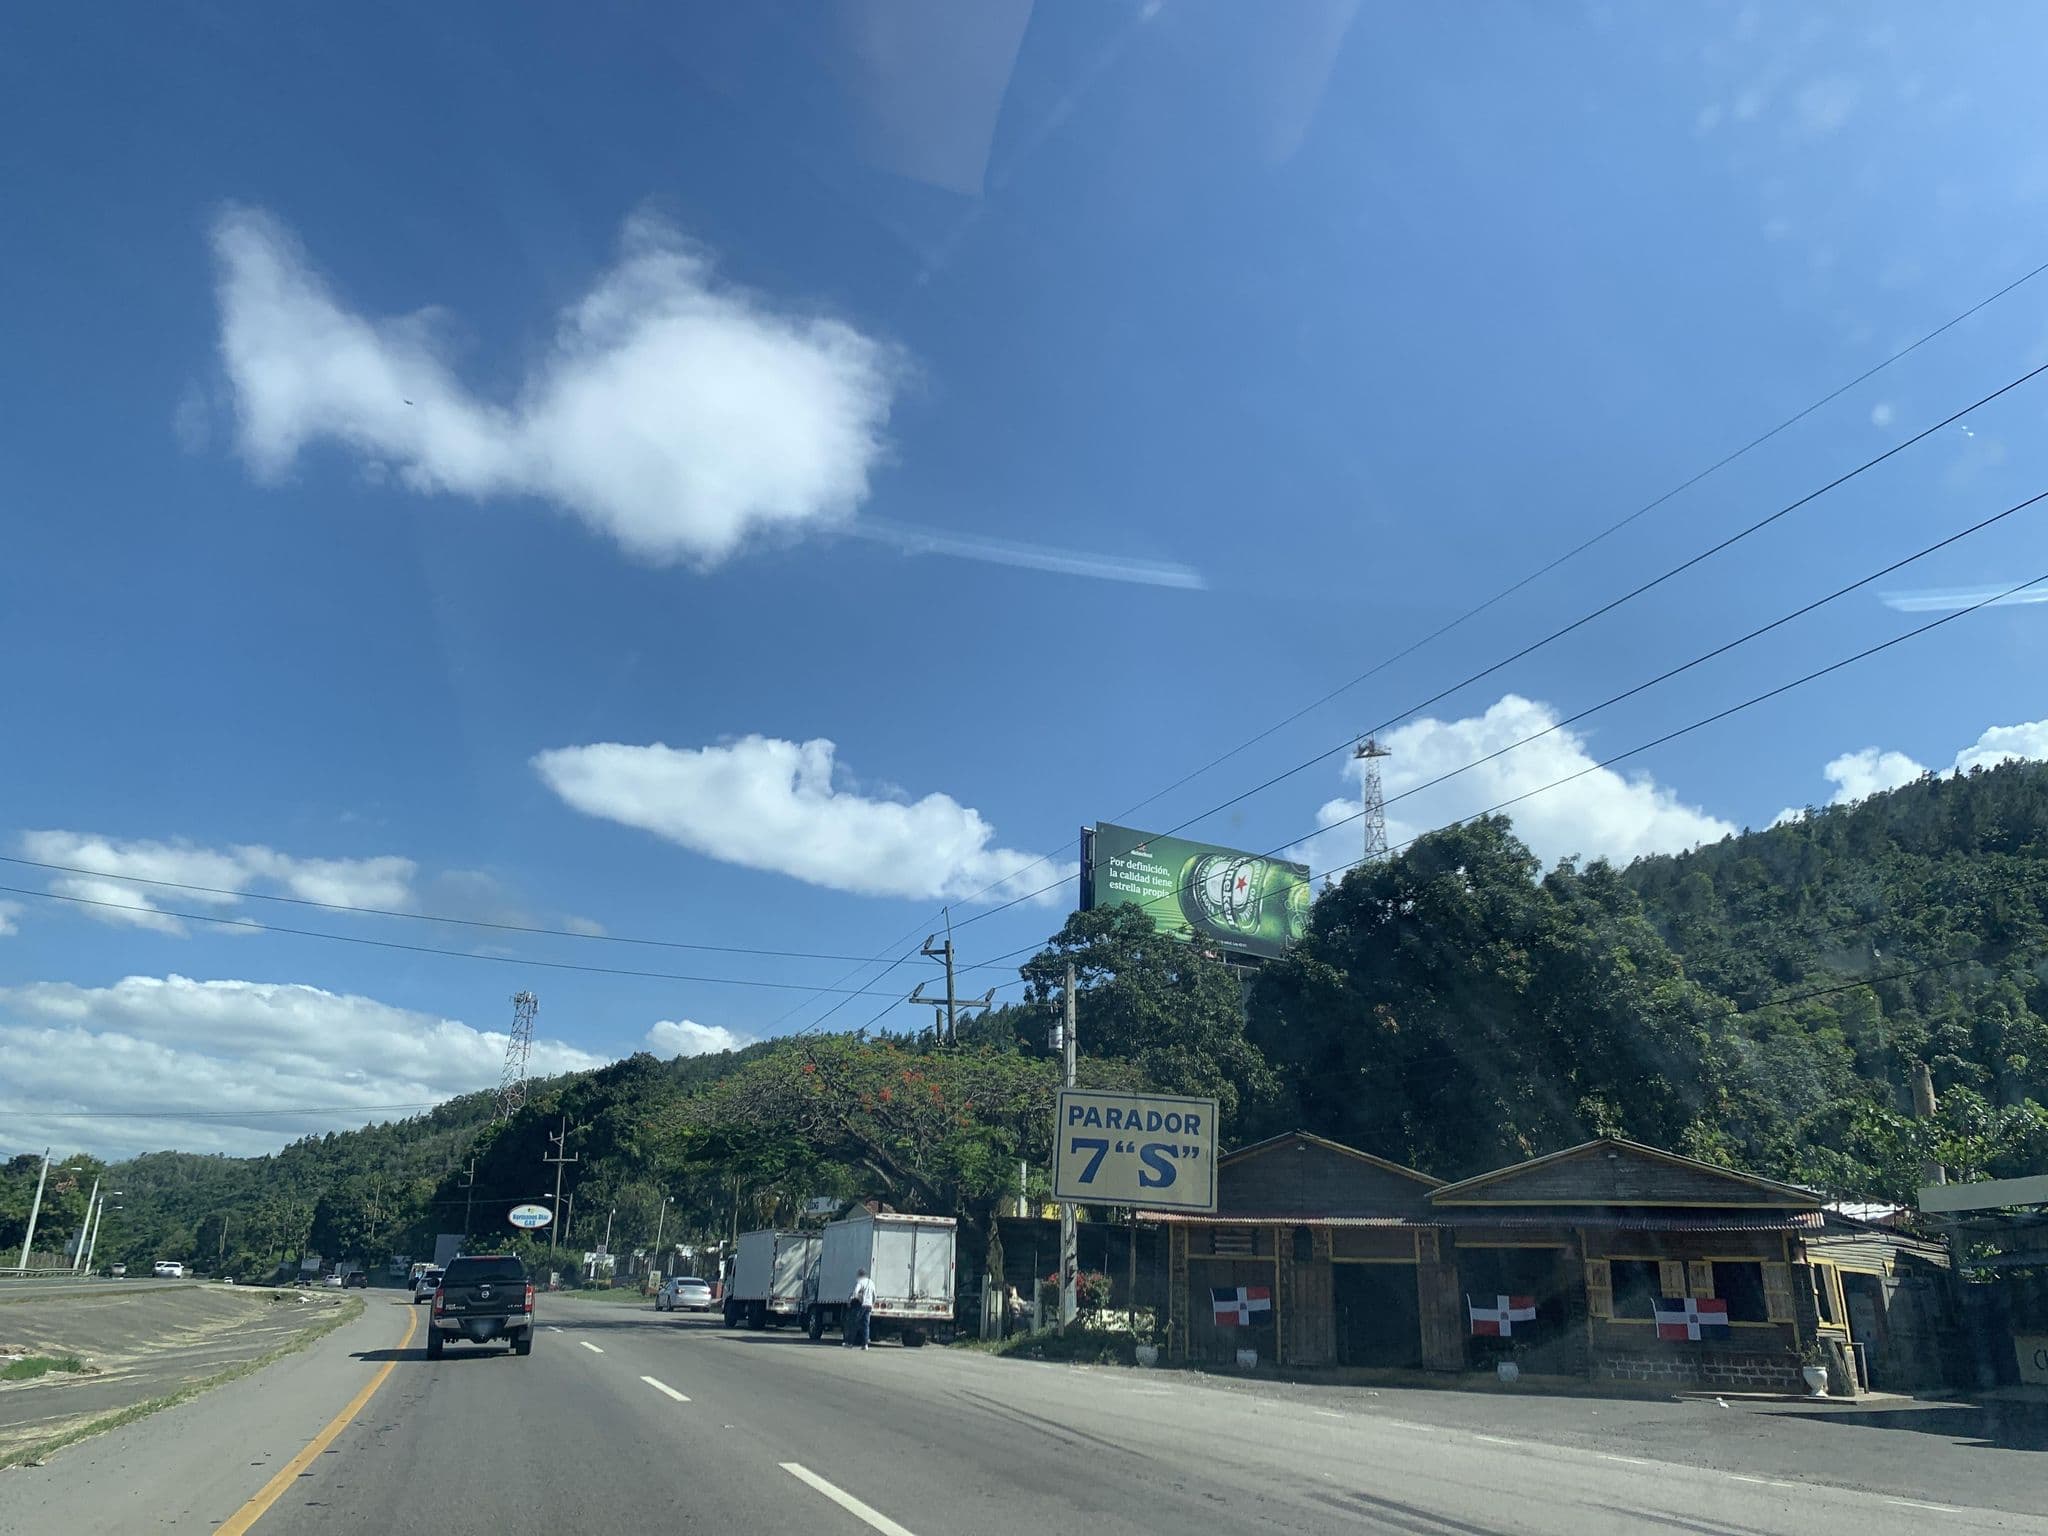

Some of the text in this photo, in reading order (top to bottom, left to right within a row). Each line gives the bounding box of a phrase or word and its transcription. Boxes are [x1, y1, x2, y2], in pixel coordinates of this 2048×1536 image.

[1110, 856, 1170, 876] Por definición,
[1109, 867, 1173, 887] la calidad tiene
[1109, 881, 1141, 893] estrella
[1068, 1105, 1201, 1135] PARADOR
